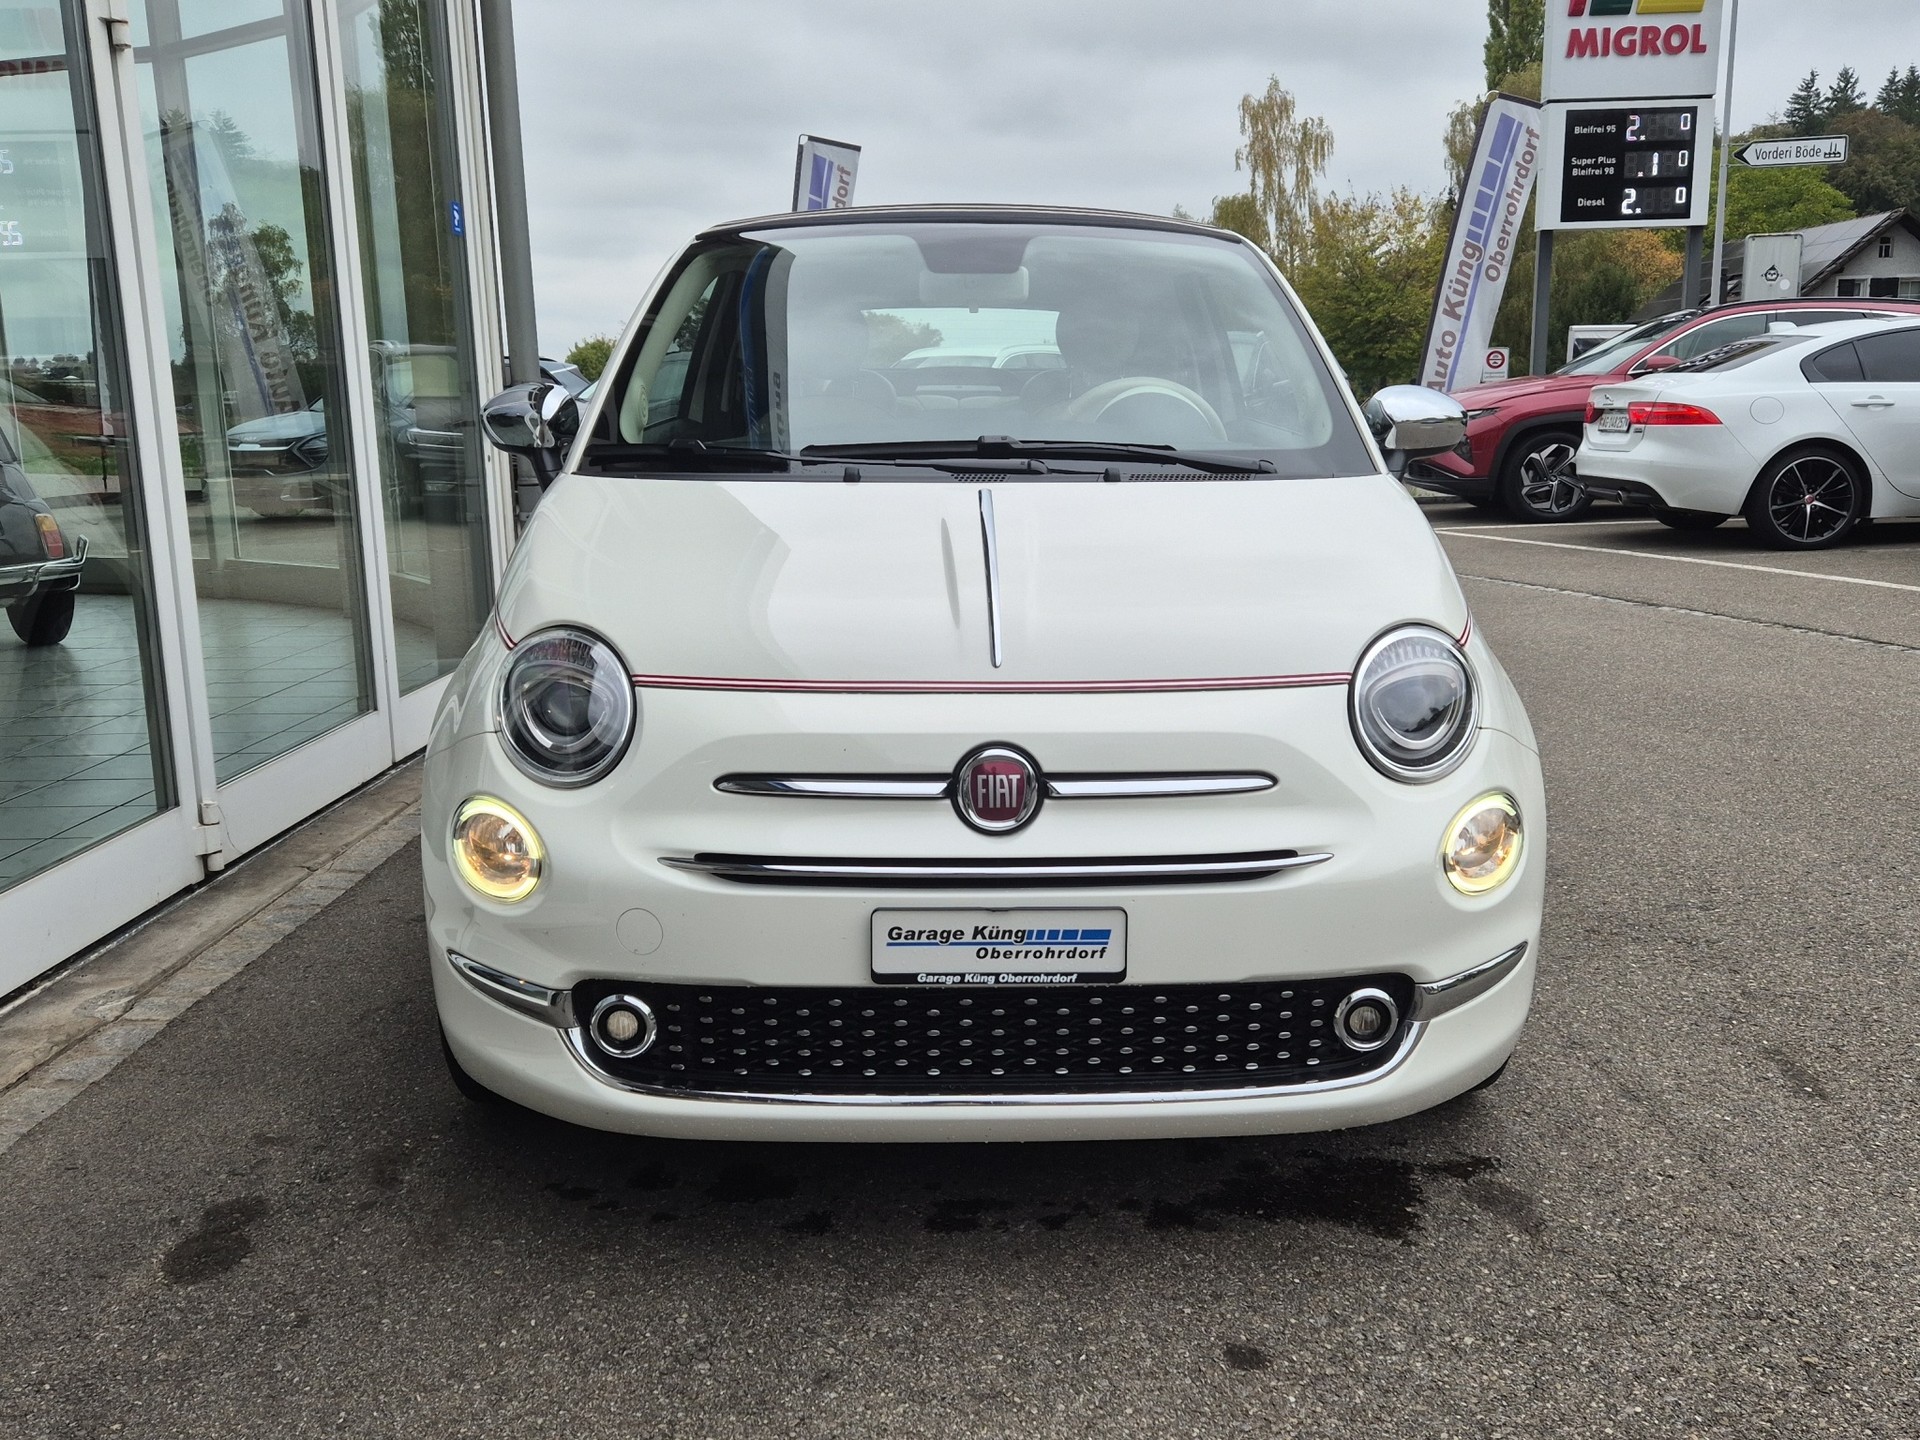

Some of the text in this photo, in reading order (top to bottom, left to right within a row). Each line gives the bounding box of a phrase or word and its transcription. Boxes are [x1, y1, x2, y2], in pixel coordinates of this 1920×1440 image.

[1565, 23, 1708, 59] MIGROL
[1574, 126, 1603, 134] Bleifrei
[1606, 125, 1617, 133] 95
[1755, 144, 1822, 160] Vorderi Böde
[1571, 156, 1617, 166] Super Plus
[1572, 167, 1615, 176] Bleifrei 98
[1484, 125, 1541, 283] Oberrohrdorf
[1577, 198, 1605, 207] Diesel
[1427, 239, 1483, 392] Auto Küng
[976, 774, 1021, 809] FIAT
[887, 925, 1027, 944] Garage Küng
[975, 946, 1109, 960] Oberrohrdorf
[917, 972, 1078, 984] Garage Küng Oberrohrdorf
